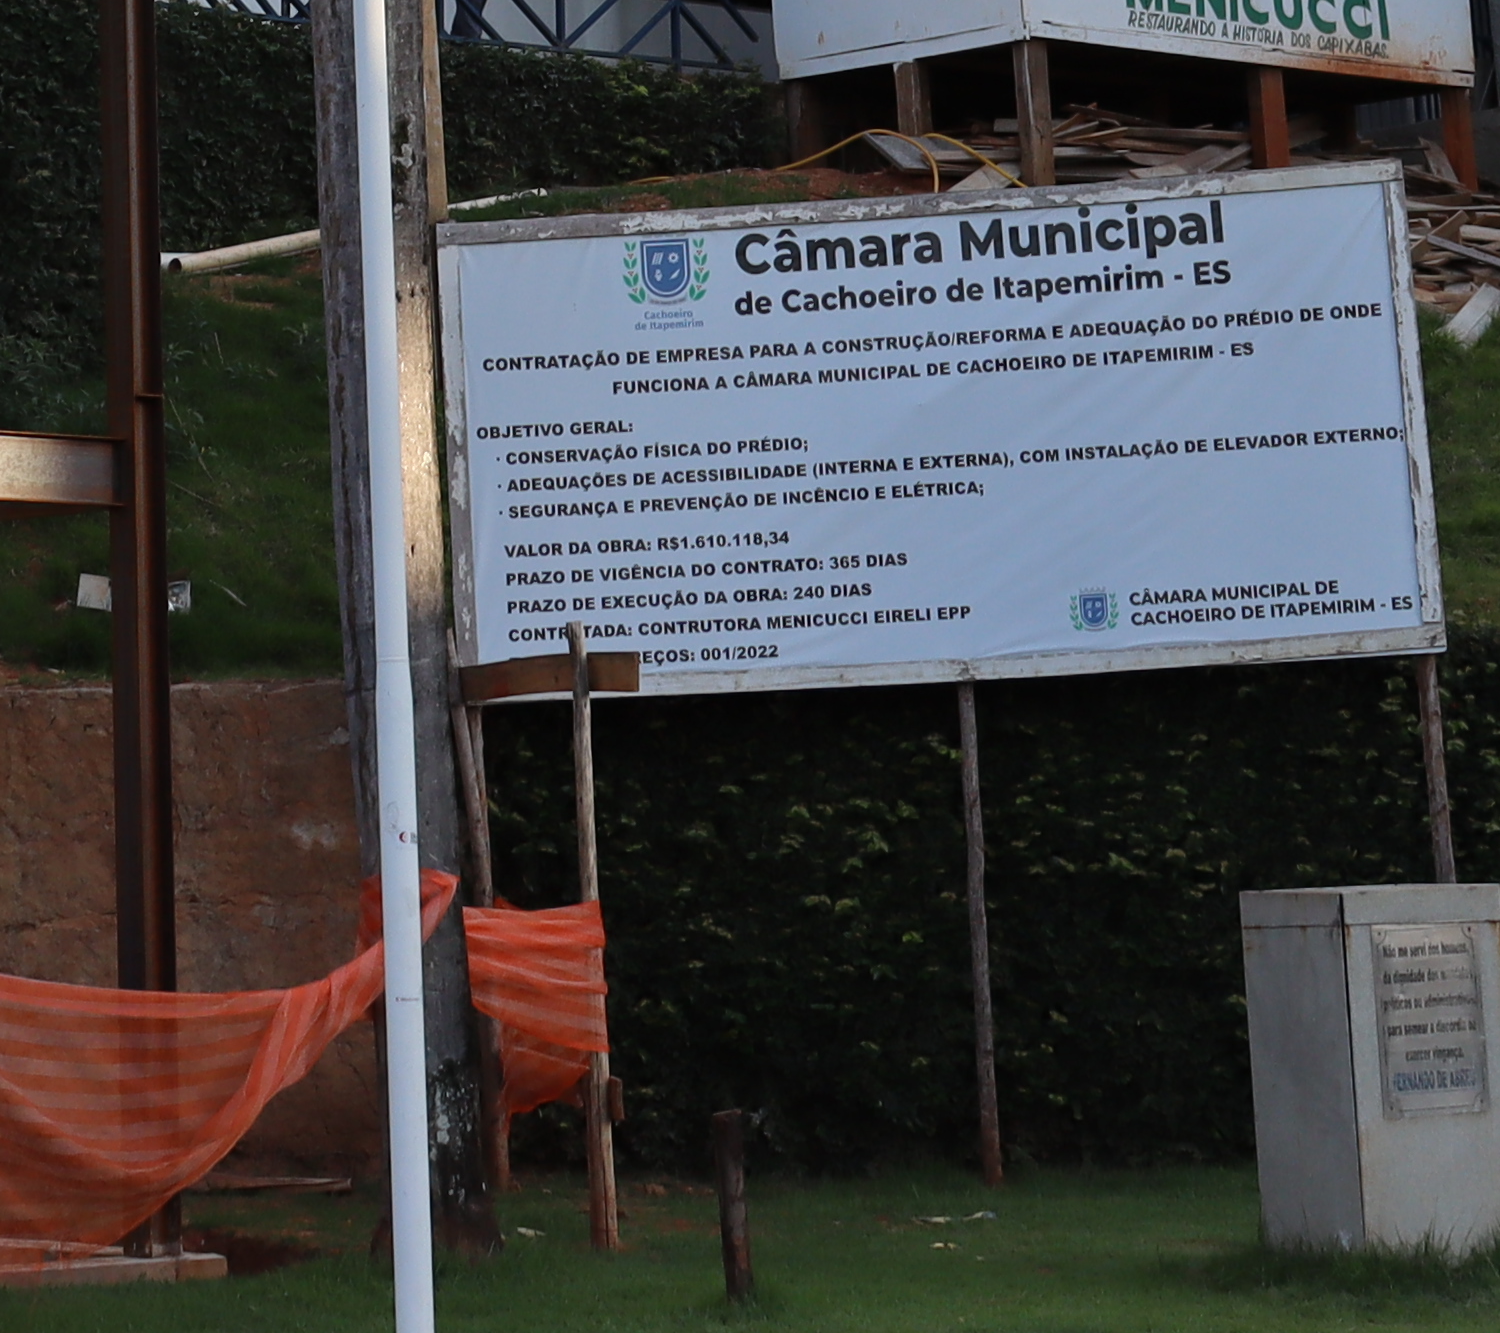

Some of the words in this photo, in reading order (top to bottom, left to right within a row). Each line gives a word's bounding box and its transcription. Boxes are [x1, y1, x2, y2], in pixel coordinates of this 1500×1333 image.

[1128, 10, 1216, 37] RESTAURANDO
[1221, 22, 1229, 39] A
[1232, 24, 1284, 47] HISTÓRIA
[1291, 30, 1312, 49] DOS
[735, 228, 943, 276] Câmara
[959, 199, 1225, 262] Municipal
[735, 291, 772, 315] de
[782, 280, 936, 313] Cachoeiro
[946, 278, 984, 302] de
[994, 258, 1163, 303] Itapemirim
[1193, 260, 1231, 285] ES
[635, 321, 647, 331] de
[649, 318, 704, 332] Itapemirim
[644, 308, 694, 321] Cachoeiro
[483, 350, 620, 371] CONTRATAÇÃO
[627, 351, 650, 365] DE
[656, 346, 744, 363] EMPRESA
[750, 343, 798, 358] PARA
[804, 342, 816, 355] A
[822, 327, 1046, 354] CONSTRUÇÃO/REFORMA
[1052, 325, 1063, 339] E
[1070, 316, 1185, 338] ADEQUAÇÃO
[1192, 315, 1217, 330] DO
[1224, 309, 1293, 327] PRÉDIO
[1300, 307, 1324, 322] DE
[1330, 303, 1382, 319] ONDE
[613, 377, 709, 395] FUNCIONA
[715, 376, 727, 389] A
[733, 371, 812, 388] CÂMARA
[818, 364, 920, 383] MUNICIPAL
[927, 362, 950, 376] DE
[957, 355, 1066, 374] CACHOEIRO
[1073, 353, 1097, 367] DE
[1103, 345, 1213, 365] ITAPEMIRIM
[1231, 342, 1254, 356] ES
[477, 424, 564, 439] OBJETIVO
[570, 420, 633, 435] GERAL:
[506, 444, 638, 465] CONSERVAÇÃO
[644, 442, 702, 458] FÍSICA
[707, 442, 731, 455] DO
[738, 436, 808, 453] PRÉDIO;
[507, 472, 627, 492] ADEQUAÇÕES
[633, 472, 656, 486] DE
[661, 464, 806, 484] ACESSIBILIDADE
[813, 459, 897, 478] (INTERNA
[903, 458, 914, 470] E
[920, 452, 1014, 469] EXTERNA),
[1020, 449, 1059, 463] COM
[1065, 440, 1178, 461] INSTALAÇÃO
[1185, 439, 1208, 453] DE
[1213, 433, 1308, 451] ELEVADOR
[1314, 427, 1406, 445] EXTERNO;
[509, 501, 618, 519] SEGURANÇA
[624, 500, 634, 513] E
[640, 493, 748, 512] PREVENÇÃO
[754, 493, 777, 506] DE
[783, 487, 869, 504] INCÊNCIO
[875, 486, 886, 499] E
[892, 481, 983, 498] ELÉTRICA;
[504, 543, 563, 558] VALOR
[569, 542, 592, 555] DA
[597, 539, 651, 553] OBRA:
[658, 531, 789, 551] R$1.610.118,34
[506, 571, 565, 586] PRAZO
[571, 569, 594, 583] DE
[599, 564, 685, 581] VIGÊNCIA
[691, 563, 715, 577] DO
[722, 558, 823, 575] CONTRATO:
[830, 555, 860, 569] 365
[866, 553, 907, 567] DIAS
[507, 599, 566, 614] PRAZO
[573, 597, 595, 611] DE
[601, 590, 698, 610] EXECUÇÃO
[704, 591, 727, 604] DA
[733, 588, 787, 603] OBRA:
[793, 586, 824, 600] 240
[831, 583, 872, 598] DIAS
[1129, 588, 1207, 606] CÂMARA
[1212, 582, 1310, 601] MUNICIPAL
[1315, 580, 1339, 595] DE
[509, 624, 632, 642] CONTRTADA:
[638, 617, 761, 635] CONTRUTORA
[767, 611, 867, 629] MENICUCCI
[874, 608, 931, 623] EIRELI
[937, 606, 970, 620] EPP
[1131, 607, 1236, 626] CACHOEIRO
[1241, 605, 1265, 619] DE
[1270, 598, 1375, 618] ITAPEMIRIM
[1391, 596, 1412, 610] ES
[701, 645, 778, 661] 001/2022
